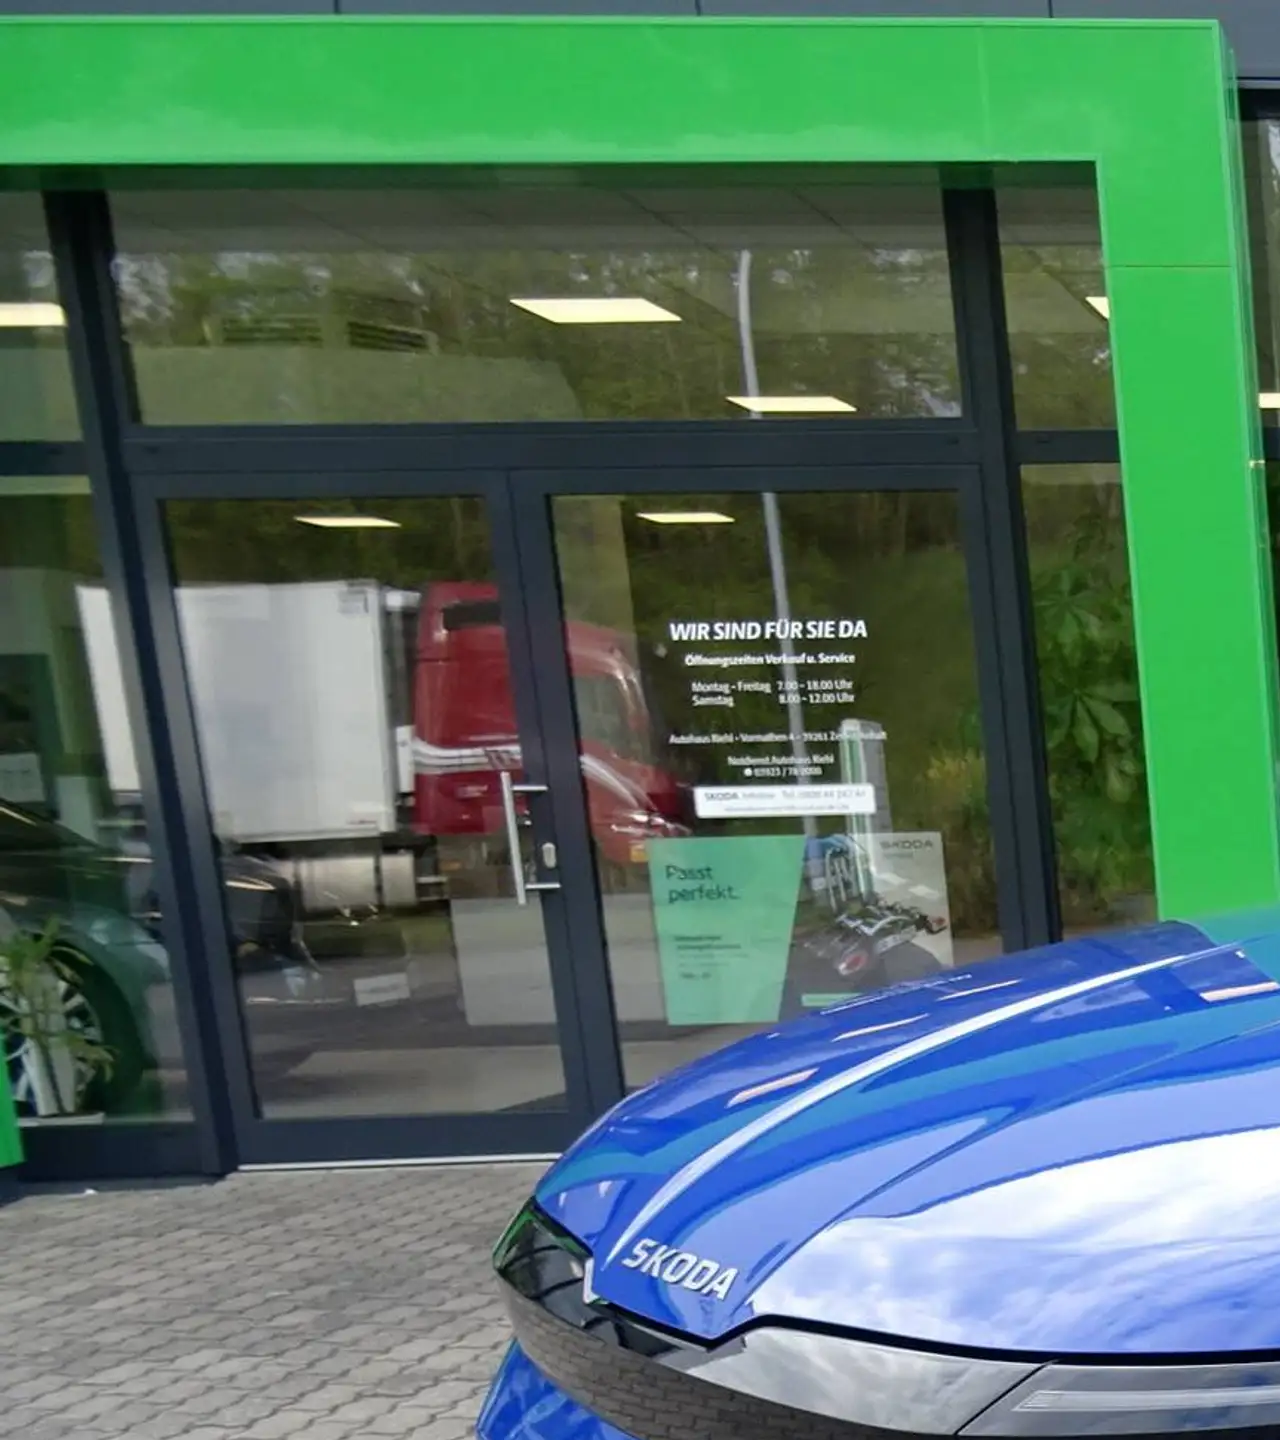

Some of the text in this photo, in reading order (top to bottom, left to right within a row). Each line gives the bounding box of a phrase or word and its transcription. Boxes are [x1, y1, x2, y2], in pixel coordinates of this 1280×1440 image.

[670, 618, 868, 641] WIR SIND FÜR SIE DA
[684, 651, 764, 667] Öffnungszeiten
[765, 652, 806, 665] Verkauf
[818, 652, 856, 664] Service
[691, 681, 731, 694] Montag
[737, 681, 771, 694] Freitag
[834, 679, 854, 690] Uhr
[692, 694, 735, 707] Samstag
[836, 693, 856, 704] Uhr
[665, 864, 713, 881] Passt
[668, 883, 741, 905] perfekt.
